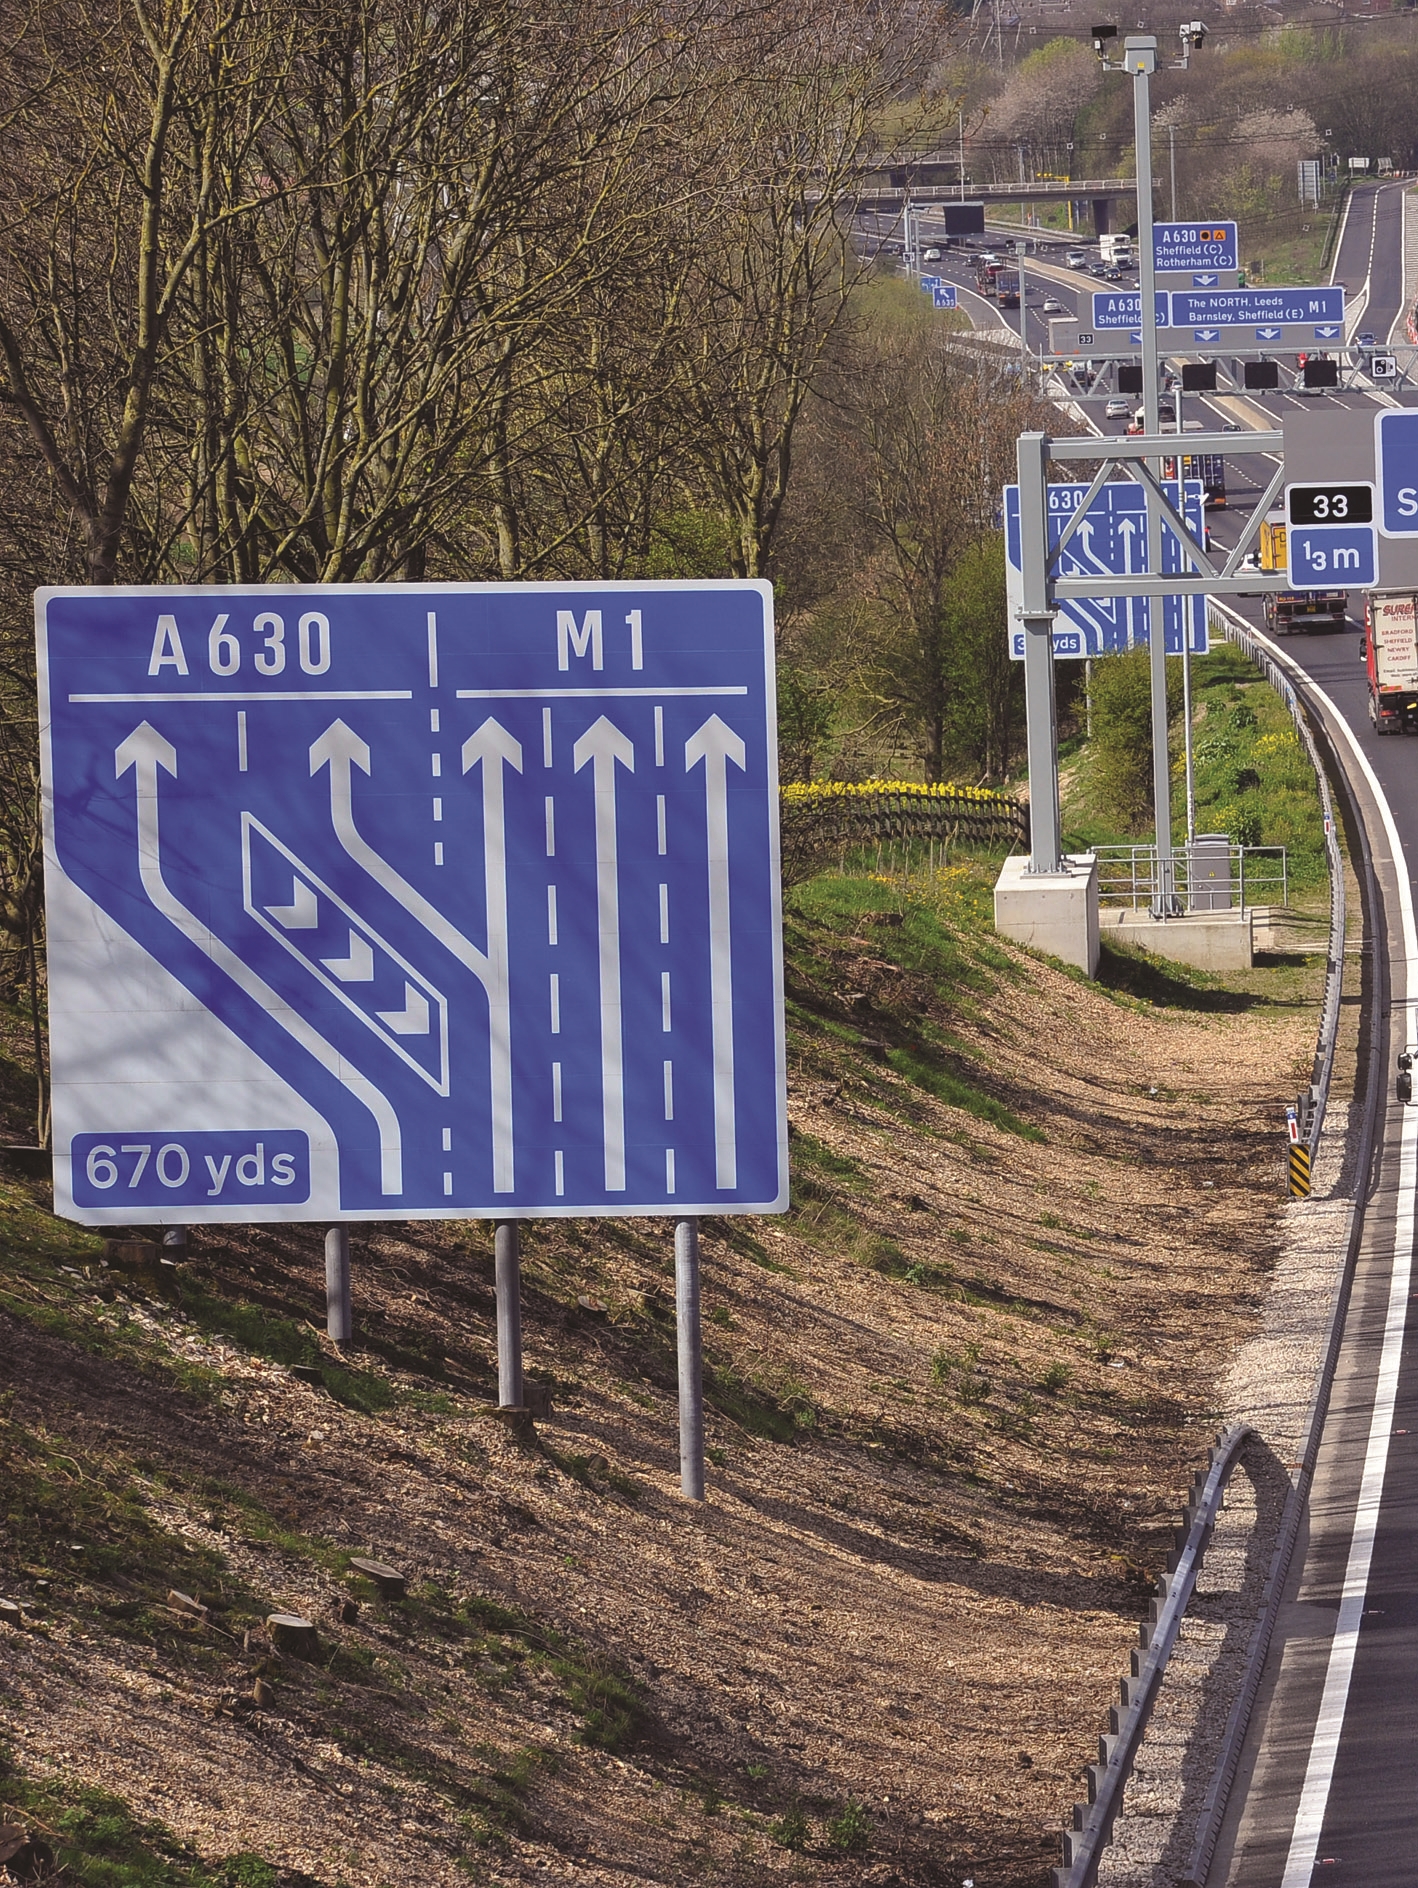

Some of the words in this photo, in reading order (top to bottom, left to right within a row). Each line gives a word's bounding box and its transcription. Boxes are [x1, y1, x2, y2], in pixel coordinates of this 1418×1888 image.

[1156, 246, 1201, 255] Sheffield
[1204, 244, 1222, 254] (C)
[1157, 258, 1211, 266] Rotherham
[1214, 256, 1232, 266] (C)
[1188, 299, 1205, 307] The
[1255, 297, 1282, 305] Leeds
[1238, 310, 1284, 320] Sheffield
[1080, 334, 1092, 344] 33
[1049, 490, 1084, 509] 630
[1314, 495, 1347, 517] 33
[1333, 549, 1359, 568] m
[1053, 635, 1077, 652] yds
[87, 1144, 189, 1189] 670
[205, 1143, 295, 1195] yds
